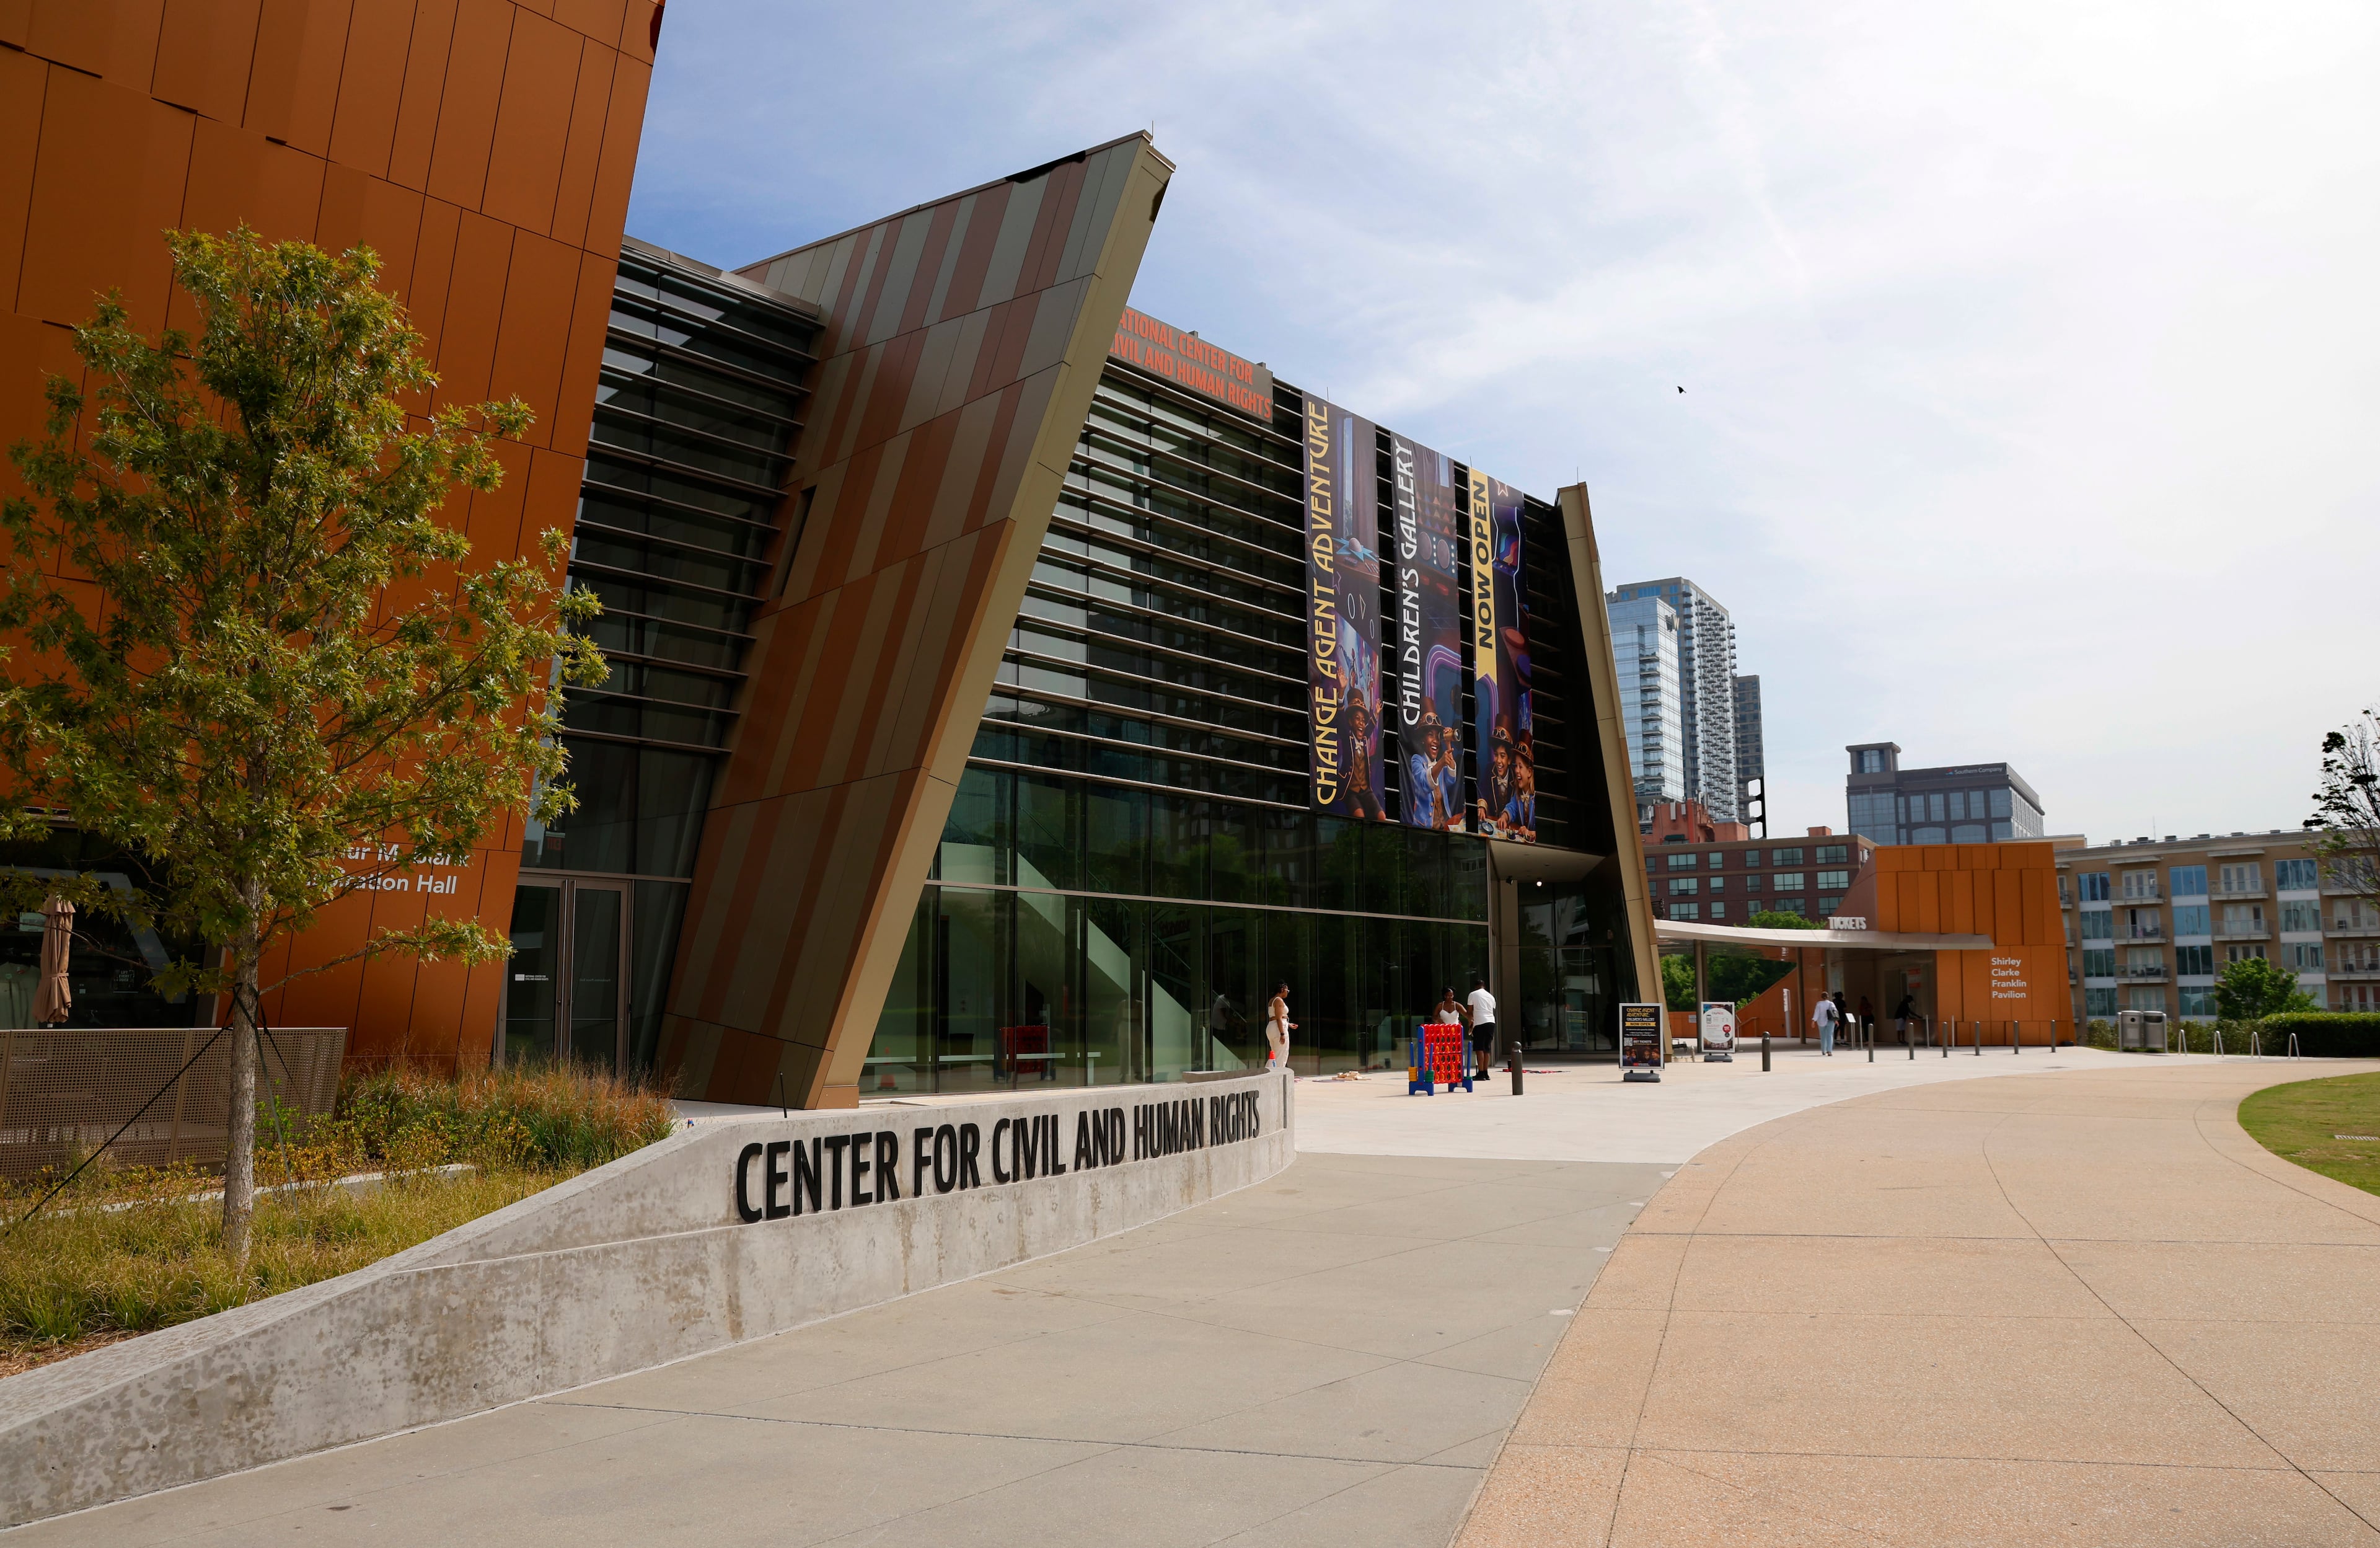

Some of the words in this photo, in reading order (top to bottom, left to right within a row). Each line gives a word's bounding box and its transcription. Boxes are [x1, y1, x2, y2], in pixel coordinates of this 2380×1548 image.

[1109, 332, 1141, 364] IVIL
[1144, 347, 1173, 376] AND
[1176, 359, 1224, 399] HUMAN
[1228, 382, 1271, 418] RIGHTS
[1119, 309, 1176, 351] ATIONAL
[1178, 334, 1227, 374] CENTER
[1229, 355, 1253, 385] FOR
[1308, 401, 1334, 573] ADVENTURE
[1395, 438, 1417, 559] GALLERY
[1473, 480, 1489, 565] OPEN
[1313, 577, 1337, 679] AGENT
[1401, 568, 1421, 725] CHILDREN'S
[1477, 570, 1492, 650] NOW
[1315, 686, 1338, 805] CHANGE
[416, 874, 457, 894] Hall
[1828, 916, 1867, 930] TICKETS
[1991, 957, 2021, 967] Shirley
[1991, 968, 2020, 976] Clarke
[1992, 991, 2026, 999] Pavilion
[736, 1131, 901, 1223] CENTER
[914, 1123, 981, 1197] FOR
[992, 1114, 1066, 1183] CIVIL
[1074, 1107, 1126, 1170] AND
[1134, 1097, 1204, 1161] HUMAN
[1210, 1090, 1260, 1146] RIGHTS
